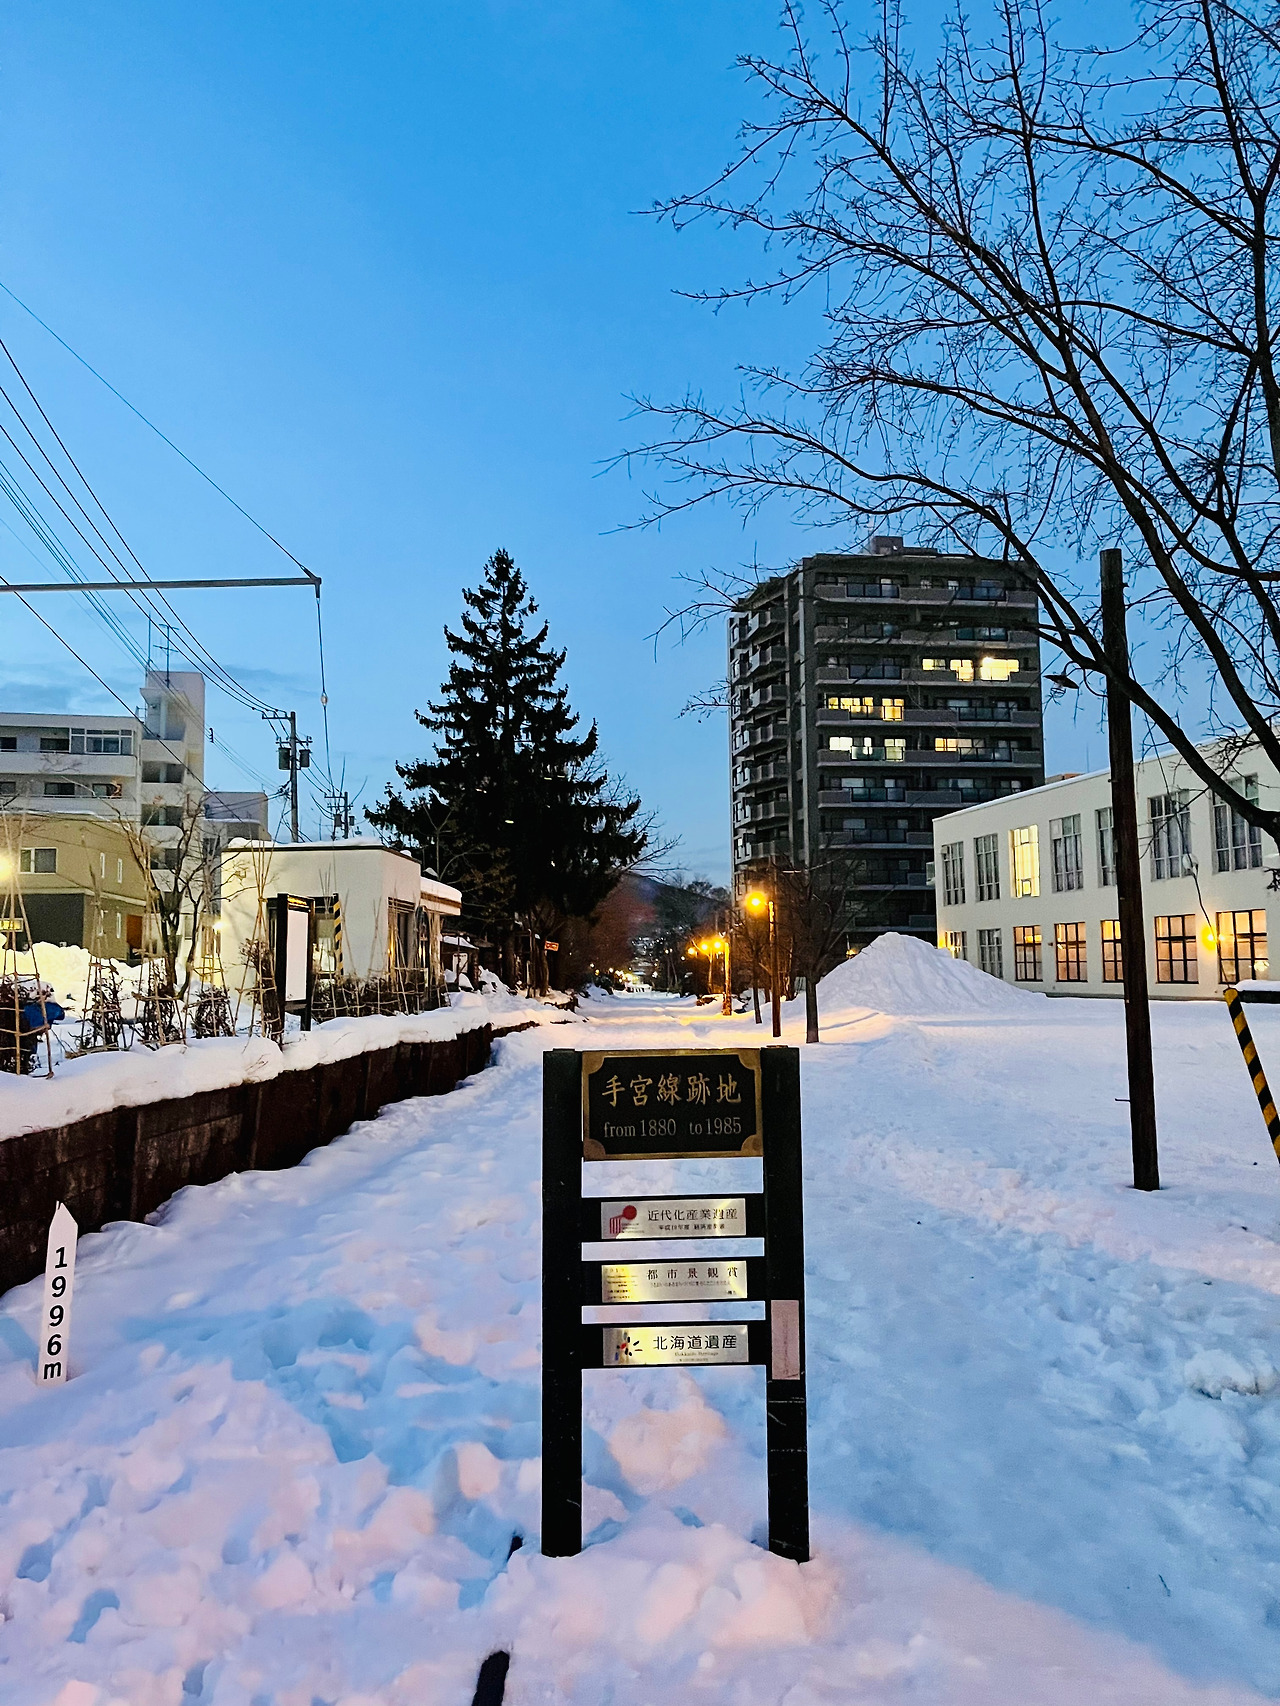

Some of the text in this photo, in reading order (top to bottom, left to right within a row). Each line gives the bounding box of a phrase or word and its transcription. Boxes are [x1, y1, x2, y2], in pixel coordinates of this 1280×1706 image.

[602, 1073, 742, 1107] 手宮線跡地
[603, 1117, 742, 1138] from 1880 to 1985
[647, 1208, 738, 1221] 近代化産業遺産
[647, 1267, 738, 1280] 都市景観賞
[653, 1334, 737, 1350] 北海道遺産
